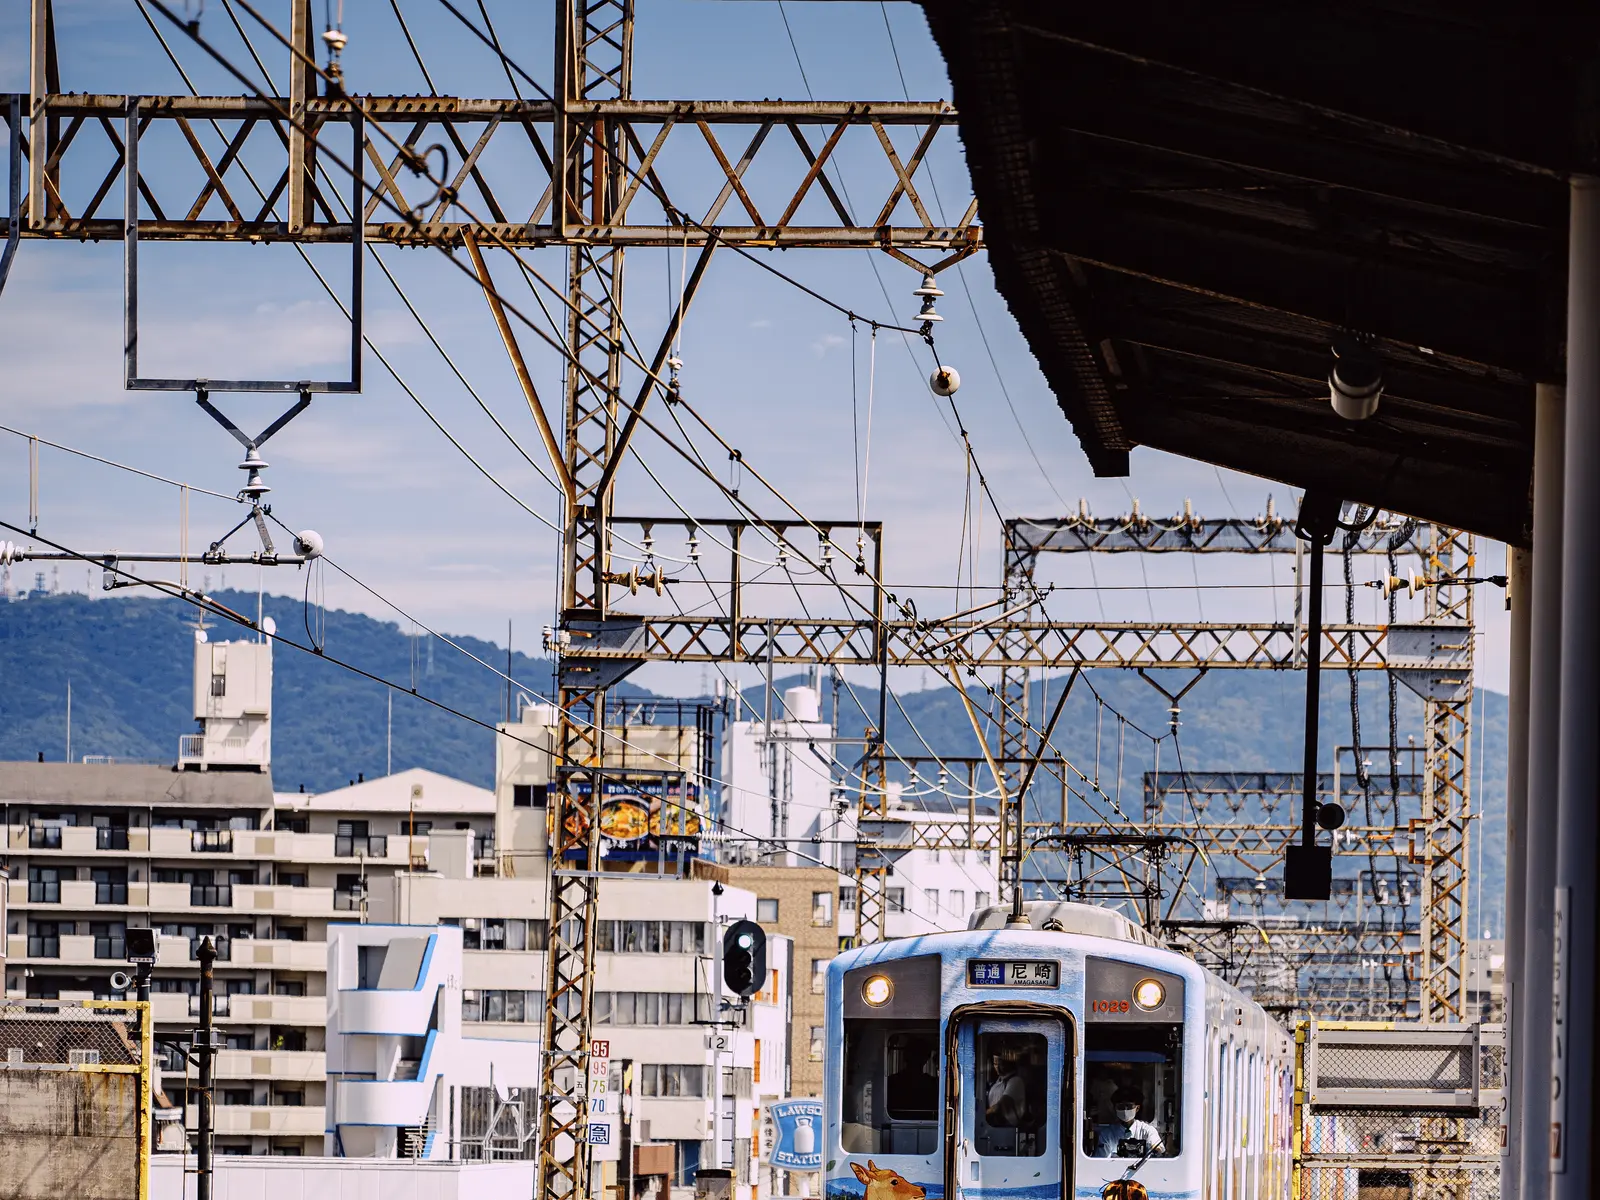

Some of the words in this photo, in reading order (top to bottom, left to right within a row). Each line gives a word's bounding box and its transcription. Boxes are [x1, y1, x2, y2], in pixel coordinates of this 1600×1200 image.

[974, 963, 1000, 979] 普通
[1011, 963, 1052, 980] 尼崎
[1092, 999, 1130, 1013] 1029
[592, 1041, 608, 1057] 95
[708, 1036, 725, 1049] 12
[592, 1061, 607, 1076] 95
[592, 1079, 606, 1094] 75
[591, 1098, 605, 1113] 70
[591, 1125, 607, 1142] 急
